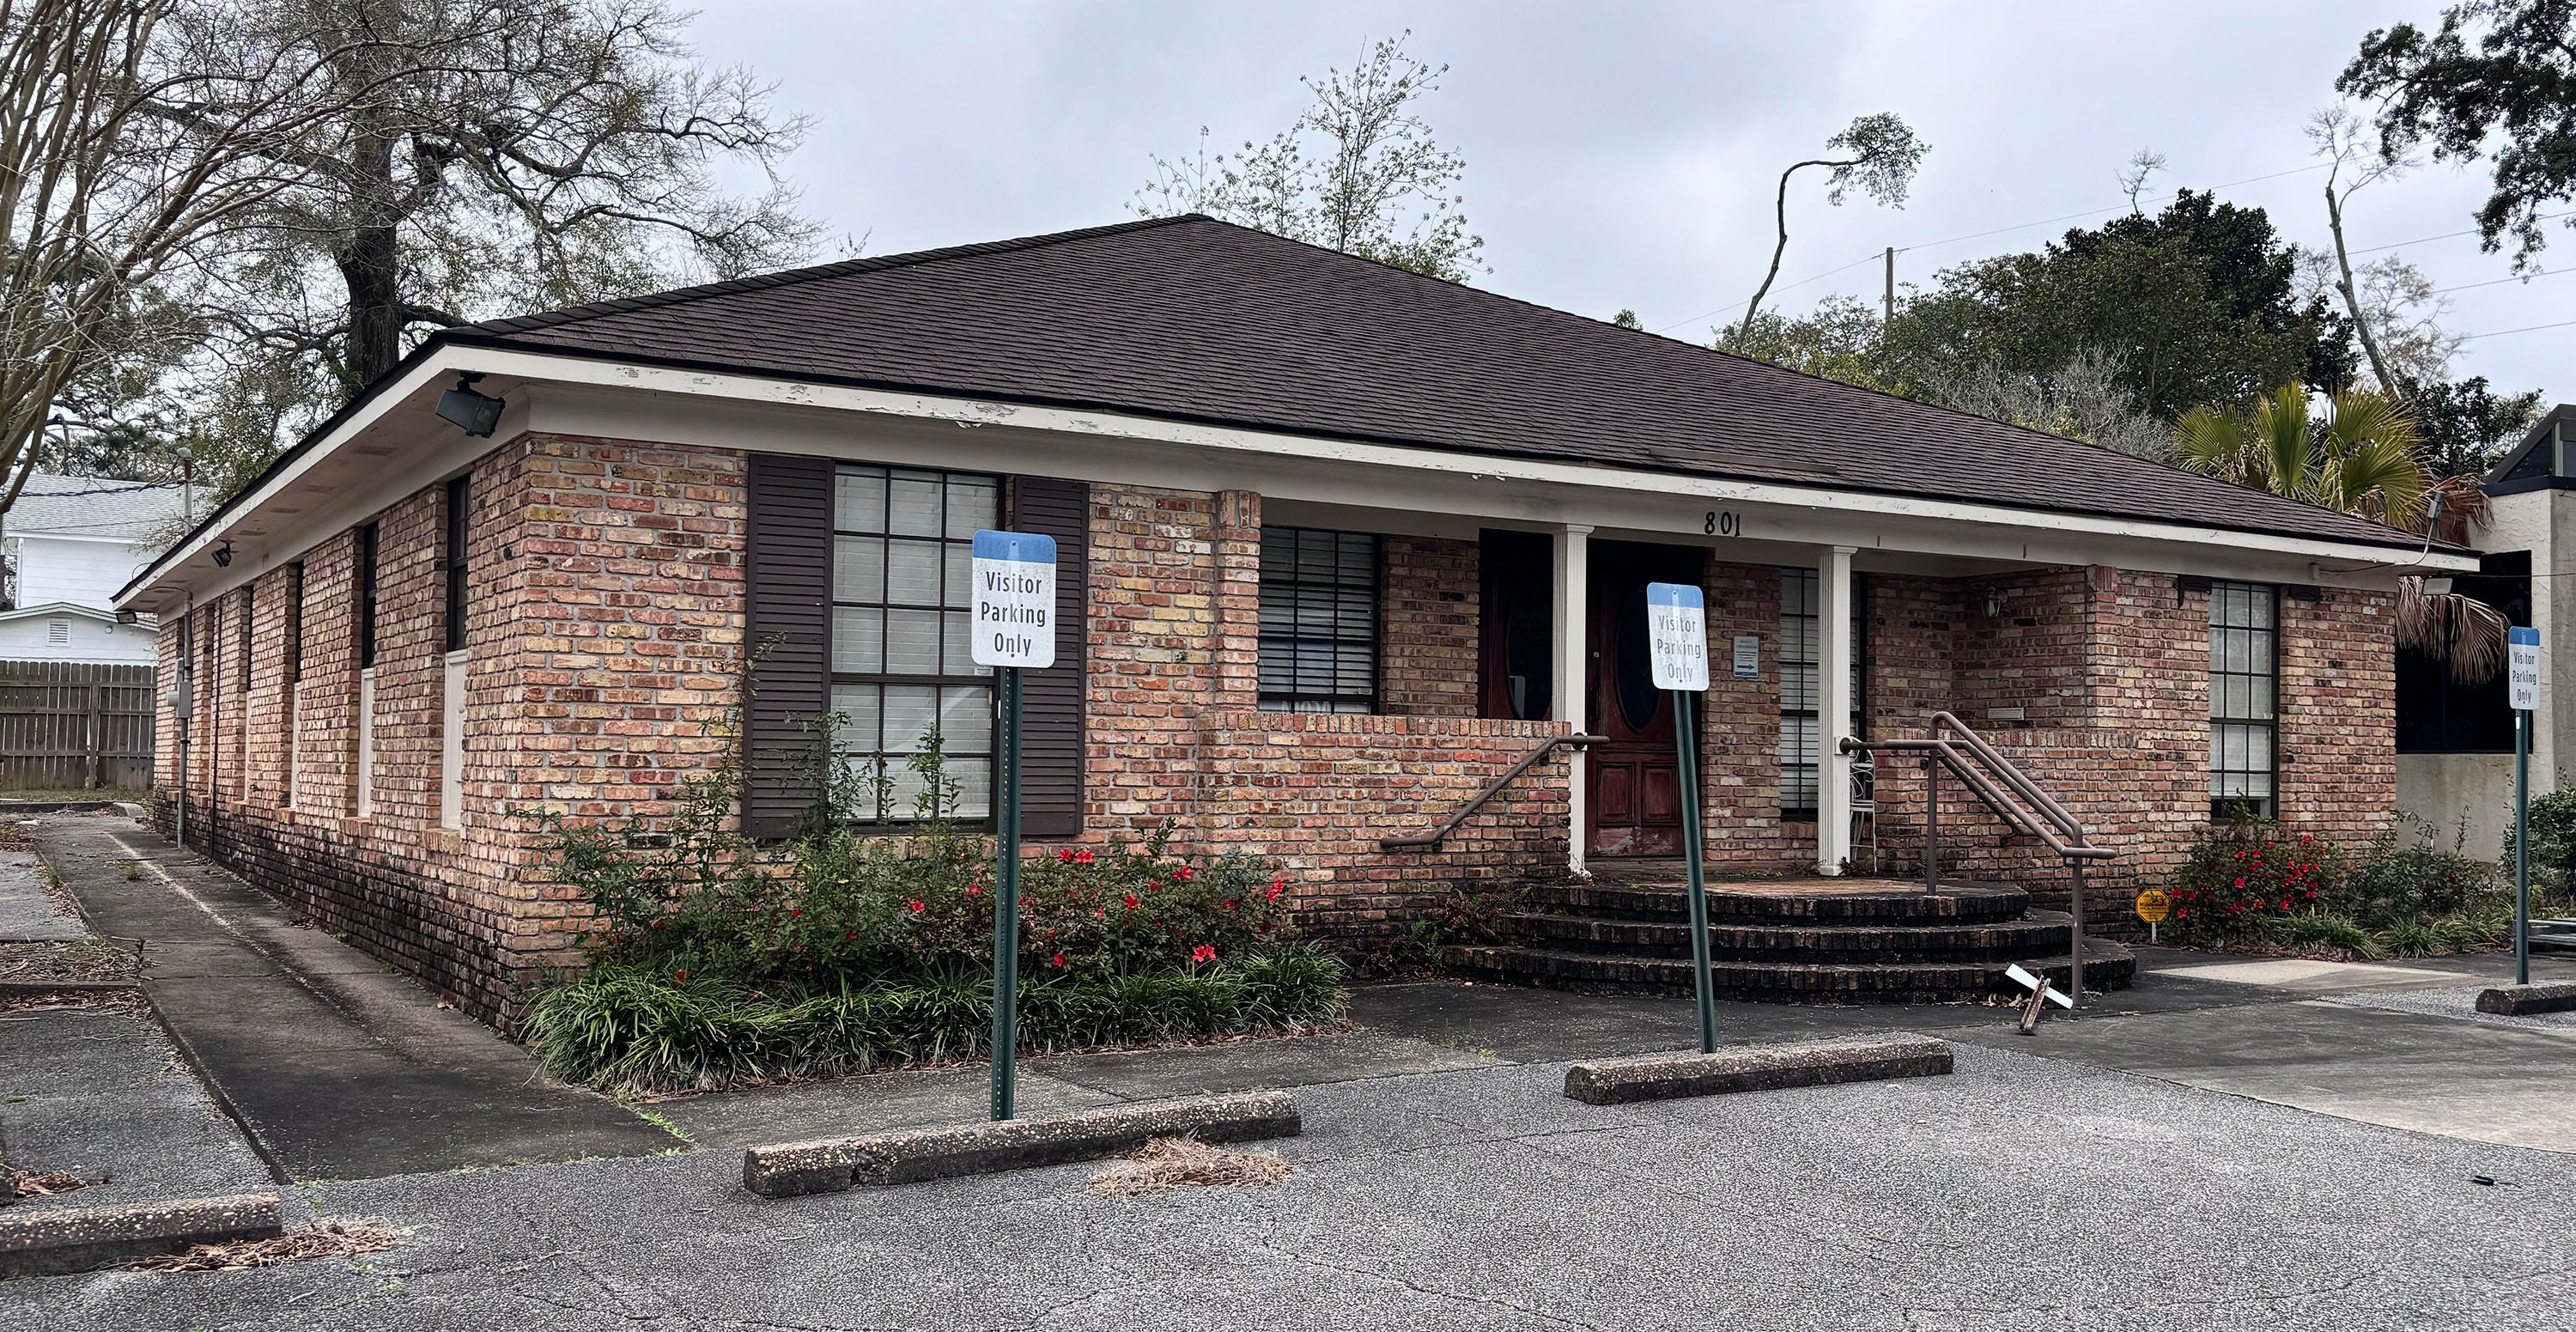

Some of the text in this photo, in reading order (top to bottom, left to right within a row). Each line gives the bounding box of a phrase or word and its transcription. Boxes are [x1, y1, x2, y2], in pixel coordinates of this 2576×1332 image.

[1704, 511, 1741, 537] 801
[987, 571, 1042, 594] Visitor
[981, 601, 1046, 628] Parking
[1658, 615, 1696, 632] Visitor
[994, 632, 1031, 657] Only
[1657, 638, 1701, 659] Parking
[2514, 651, 2535, 665] Visitor
[1668, 663, 1693, 682] Only
[2512, 670, 2537, 685] Parking
[2517, 689, 2531, 703] Only
